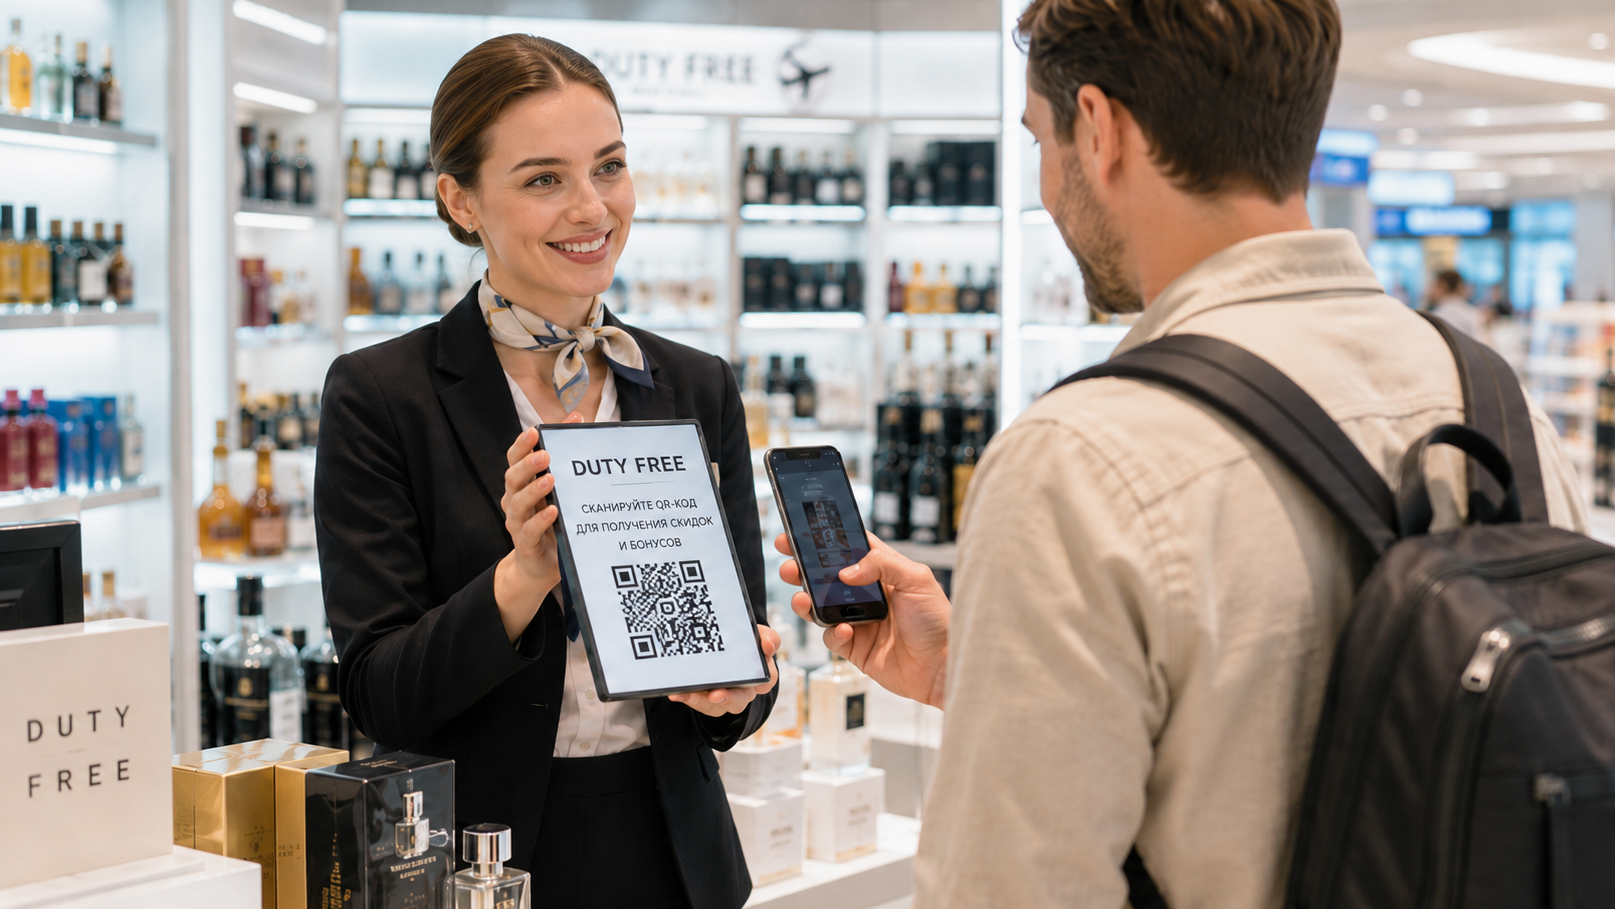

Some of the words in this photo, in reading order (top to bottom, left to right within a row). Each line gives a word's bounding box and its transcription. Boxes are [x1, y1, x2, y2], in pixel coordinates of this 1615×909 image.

[686, 53, 755, 84] FREE
[571, 458, 627, 476] DUTY
[634, 455, 686, 473] FREE
[581, 499, 654, 514] СКАНИРУЙТЕ
[655, 498, 698, 510] QR-КОД
[576, 523, 599, 535] ДЛЯ
[602, 518, 668, 532] ПОЛУЧЕНИЯ
[670, 516, 714, 529] СКИДОК
[618, 541, 628, 551] И
[630, 537, 682, 550] БОНУСОВ
[27, 705, 130, 743] DUTY
[28, 759, 130, 798] FREE
